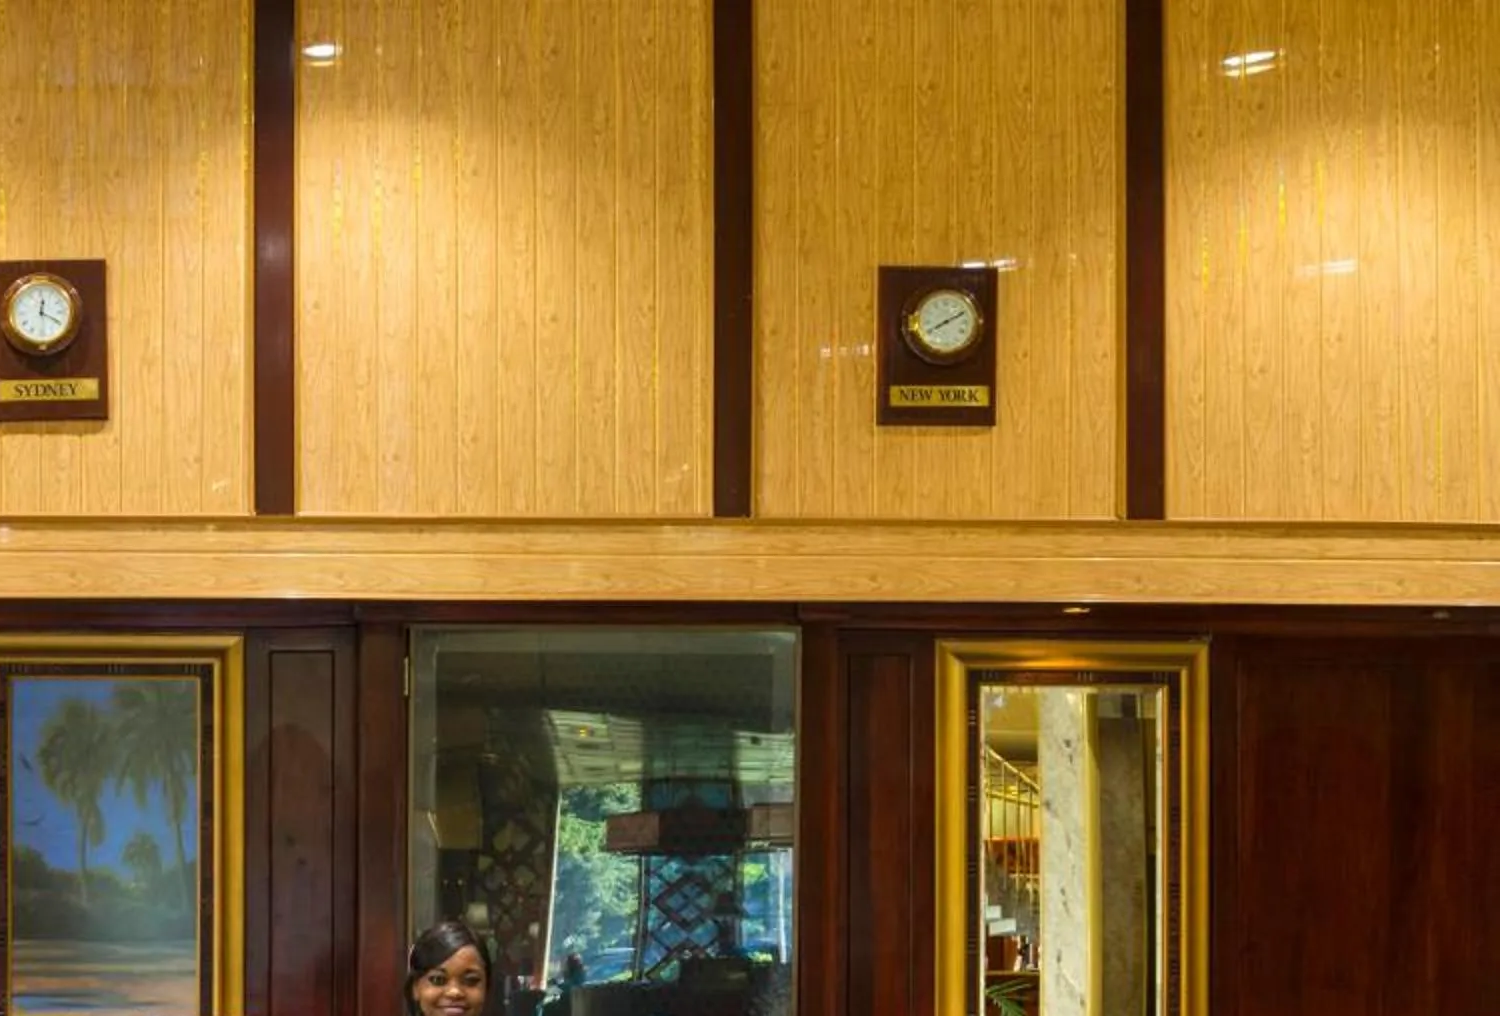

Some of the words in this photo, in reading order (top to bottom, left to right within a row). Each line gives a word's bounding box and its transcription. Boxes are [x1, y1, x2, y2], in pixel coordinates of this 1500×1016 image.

[14, 383, 78, 396] SYDNEY
[900, 390, 932, 401] NEW
[939, 390, 979, 402] YORK
